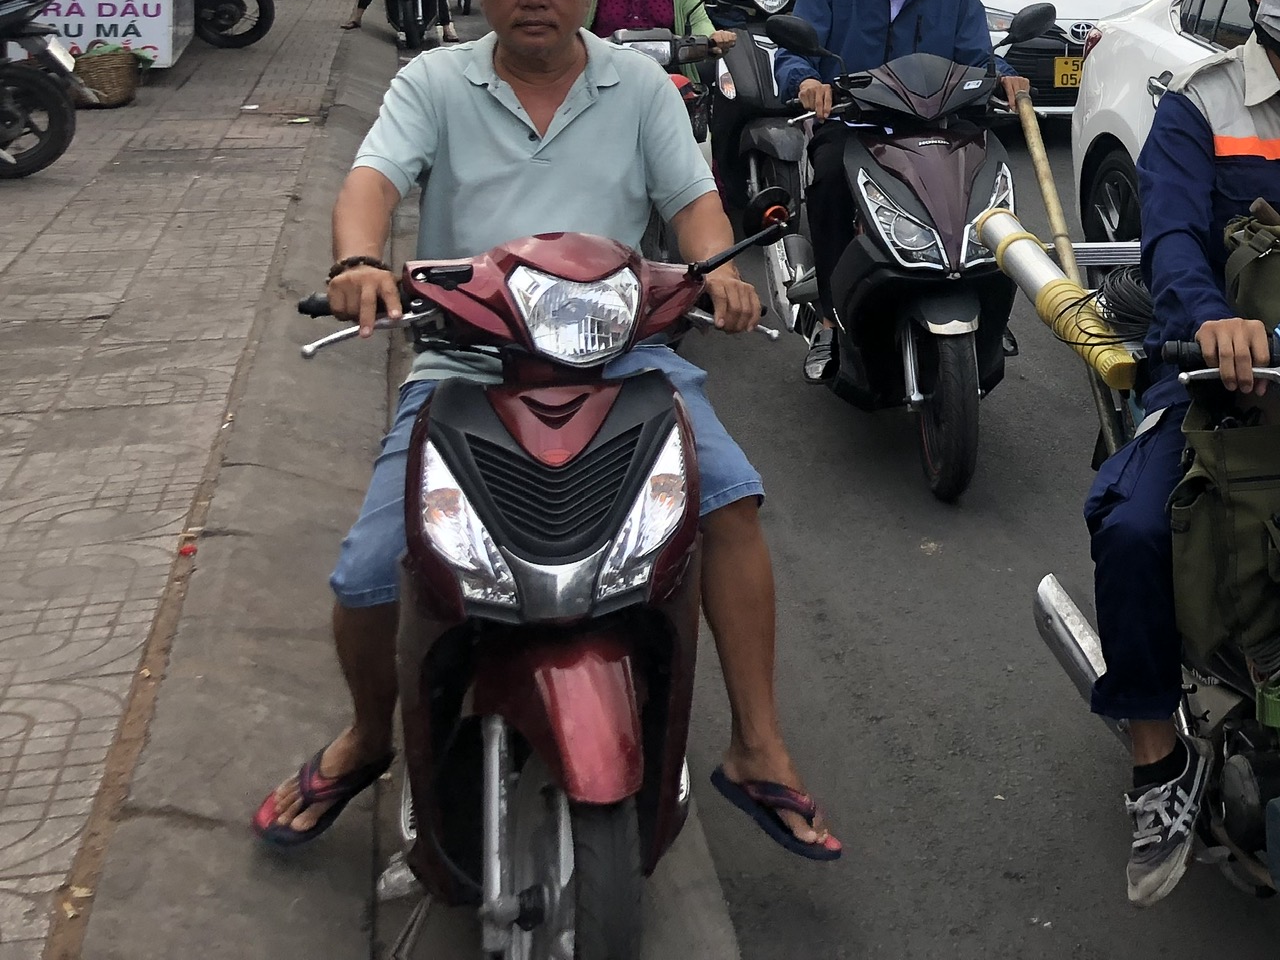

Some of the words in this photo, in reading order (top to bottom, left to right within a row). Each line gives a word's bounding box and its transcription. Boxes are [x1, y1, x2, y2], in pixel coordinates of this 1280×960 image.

[42, 0, 86, 17] RÀ
[97, 0, 162, 18] DÂU
[96, 20, 142, 38] MÁ
[1061, 74, 1081, 85] 05
